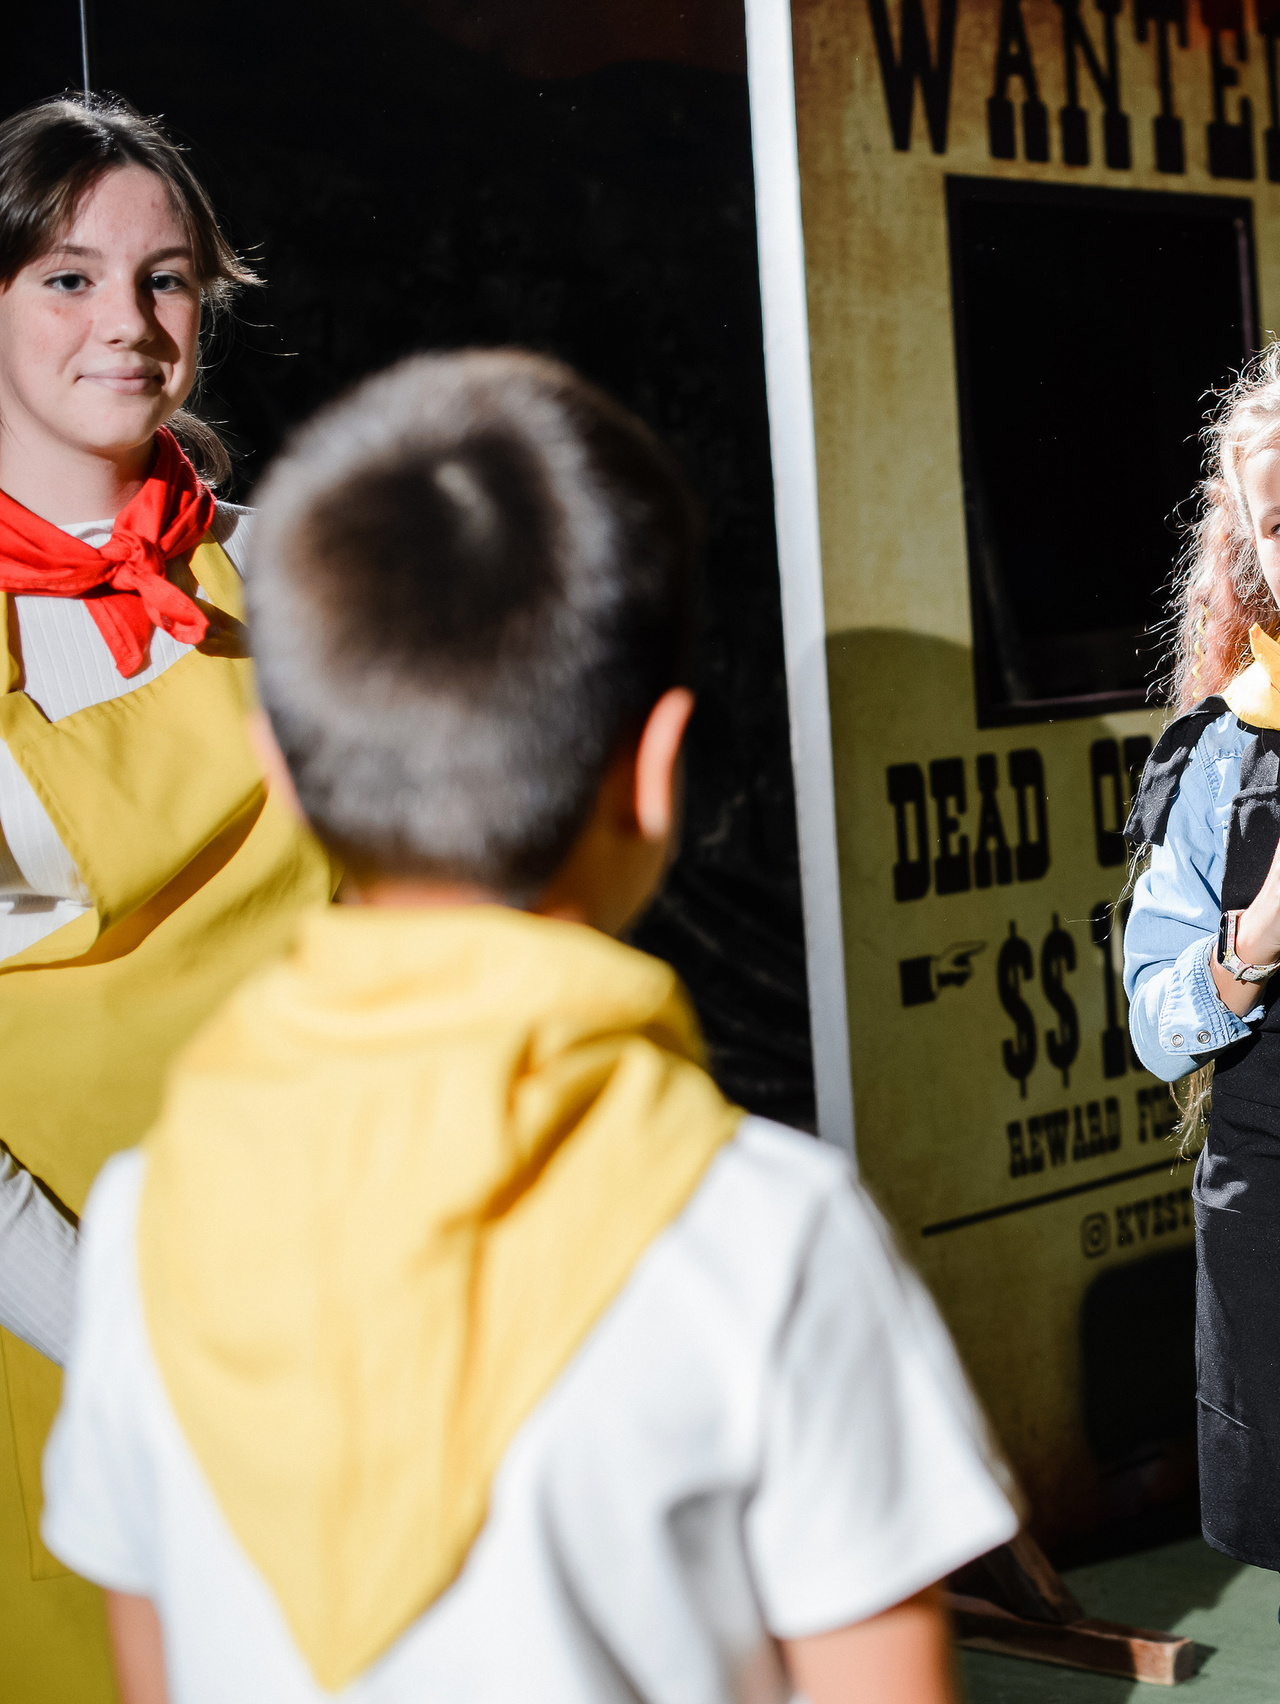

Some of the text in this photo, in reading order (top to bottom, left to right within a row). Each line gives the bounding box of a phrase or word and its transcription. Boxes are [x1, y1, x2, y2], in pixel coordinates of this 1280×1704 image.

[886, 748, 1050, 902] DEAD
[997, 902, 1144, 1099] $$1
[1007, 1096, 1121, 1179] REWARD
